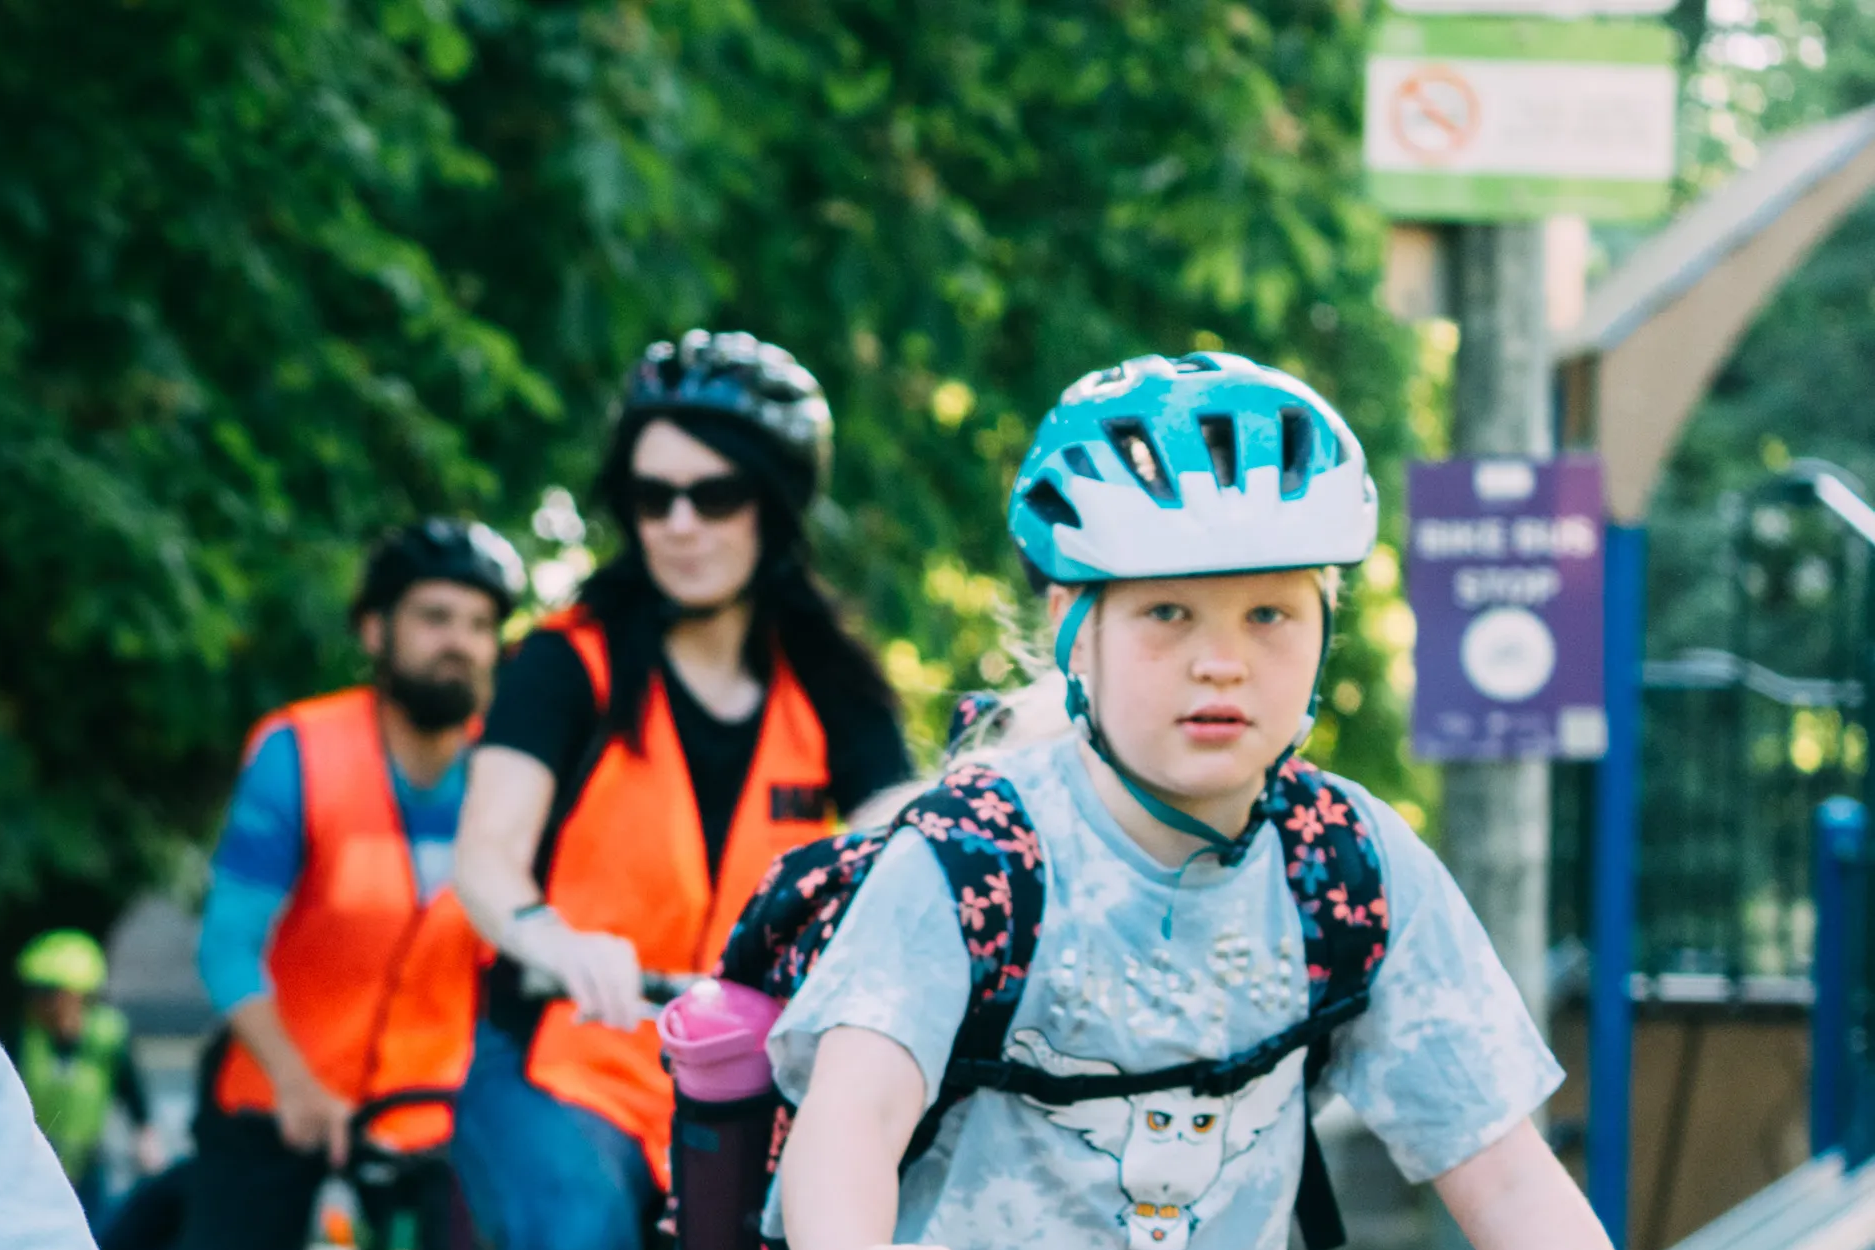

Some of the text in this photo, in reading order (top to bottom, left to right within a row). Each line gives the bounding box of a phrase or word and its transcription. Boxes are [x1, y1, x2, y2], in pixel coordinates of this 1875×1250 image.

[1417, 517, 1599, 560] BIKE BUS
[1453, 565, 1562, 607] STOP
